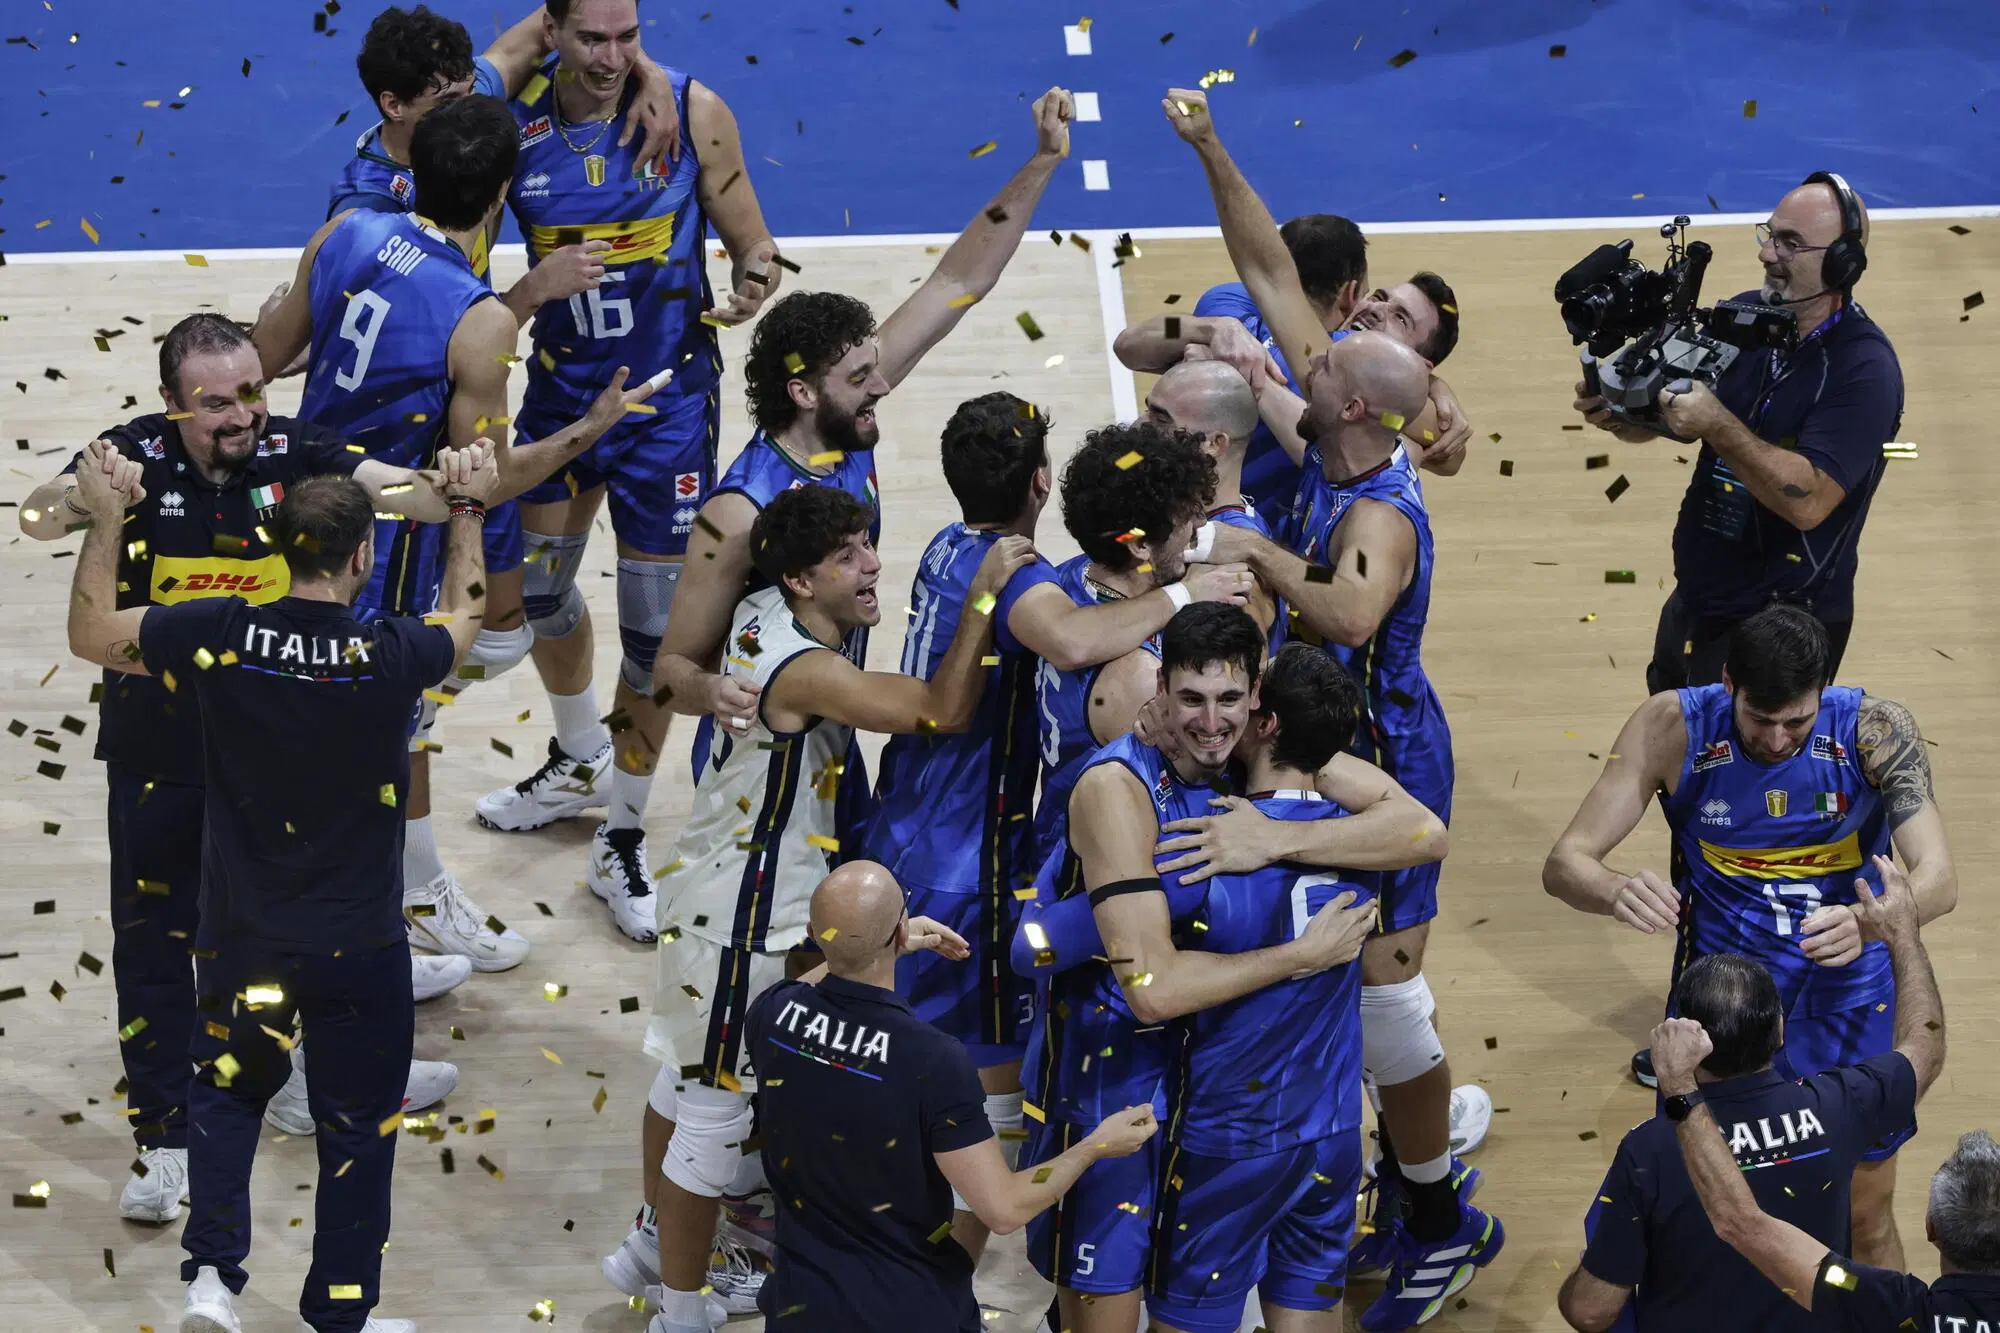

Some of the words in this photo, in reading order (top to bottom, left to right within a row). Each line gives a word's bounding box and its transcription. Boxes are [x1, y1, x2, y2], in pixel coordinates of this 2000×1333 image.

[638, 177, 669, 192] ITA
[377, 235, 428, 276] SANI
[569, 271, 635, 339] 16
[335, 288, 391, 393] 9
[671, 525, 693, 534] erre
[184, 573, 263, 592] DHL
[245, 624, 372, 665] ITALIA
[1019, 993, 1035, 1024] 3
[775, 1000, 891, 1065] ITALIA
[1720, 1107, 1826, 1155] ALIA
[1076, 1243, 1096, 1275] 5
[1934, 1314, 2000, 1333] ITA
